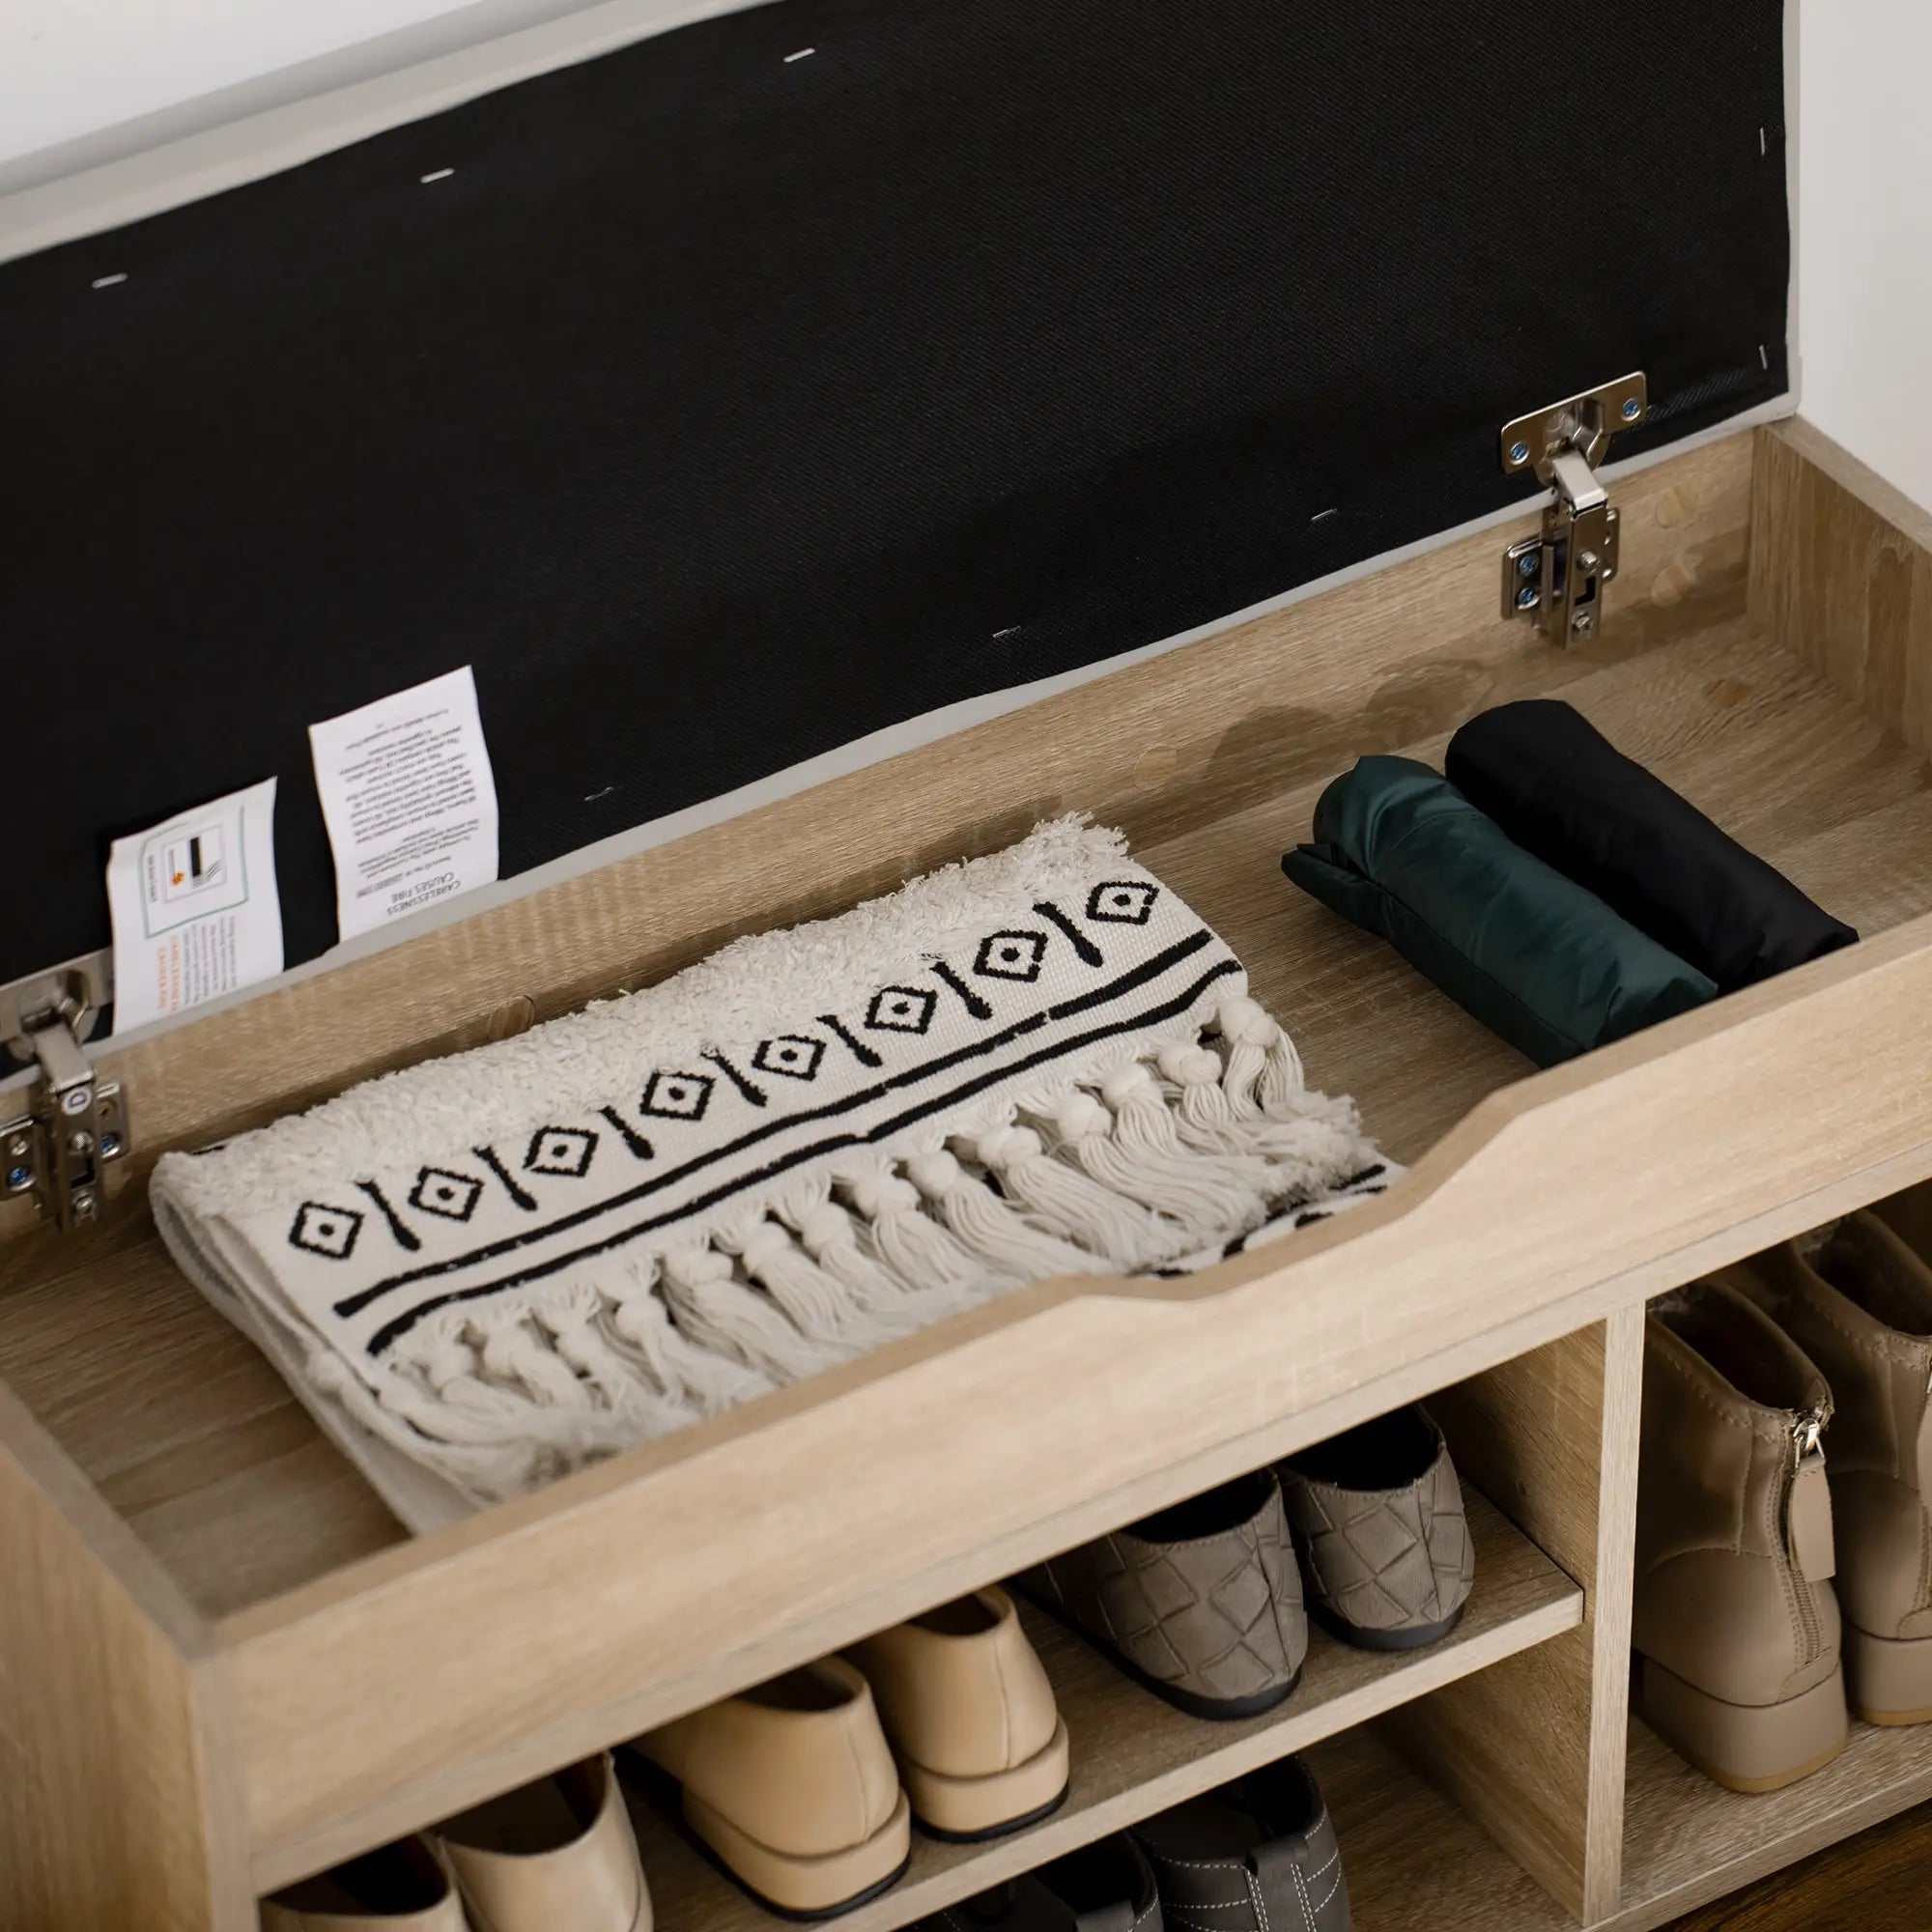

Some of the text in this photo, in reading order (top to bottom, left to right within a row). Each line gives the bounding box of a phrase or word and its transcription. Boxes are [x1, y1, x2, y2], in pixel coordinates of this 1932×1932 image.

[414, 871, 455, 894] CAUSES
[386, 880, 461, 916] CARELESSNESS
[391, 888, 412, 903] FIRE
